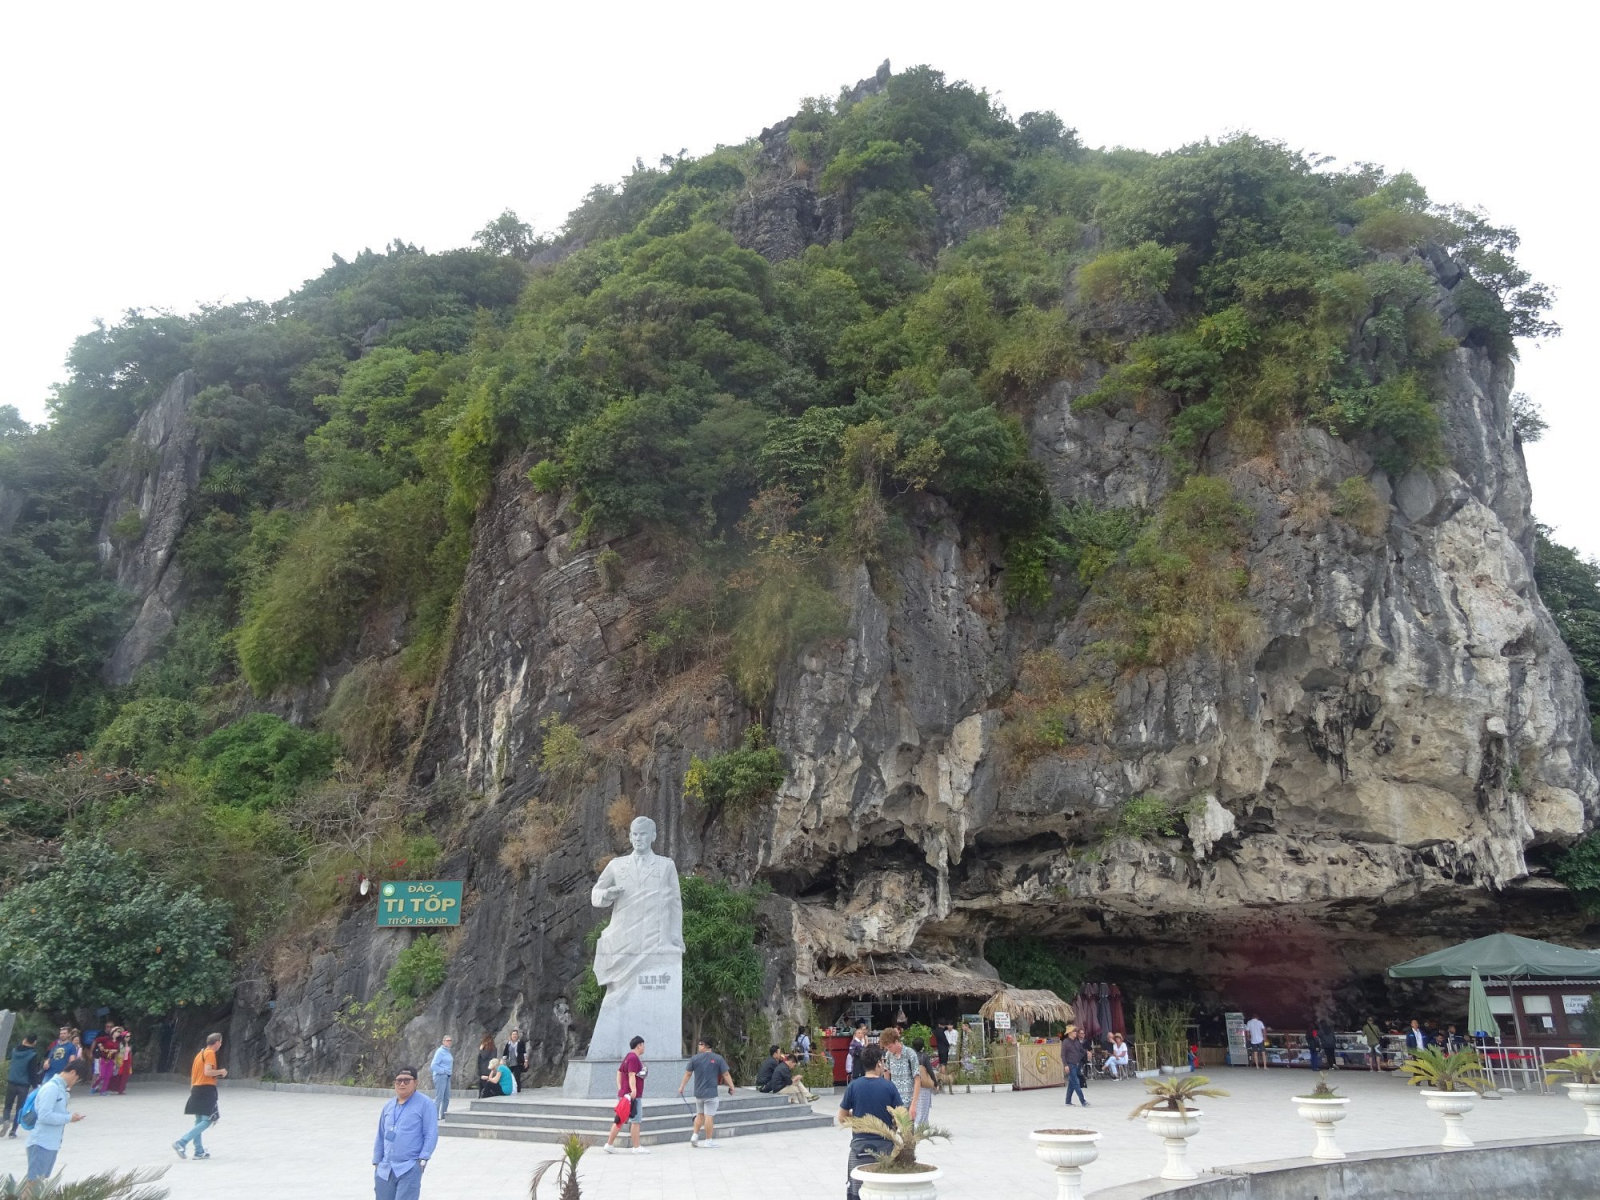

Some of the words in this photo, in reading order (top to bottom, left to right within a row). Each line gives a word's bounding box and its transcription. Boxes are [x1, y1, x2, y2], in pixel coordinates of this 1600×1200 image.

[408, 883, 434, 893] ĐẢO
[384, 899, 404, 912] TI
[410, 891, 456, 912] TỐP
